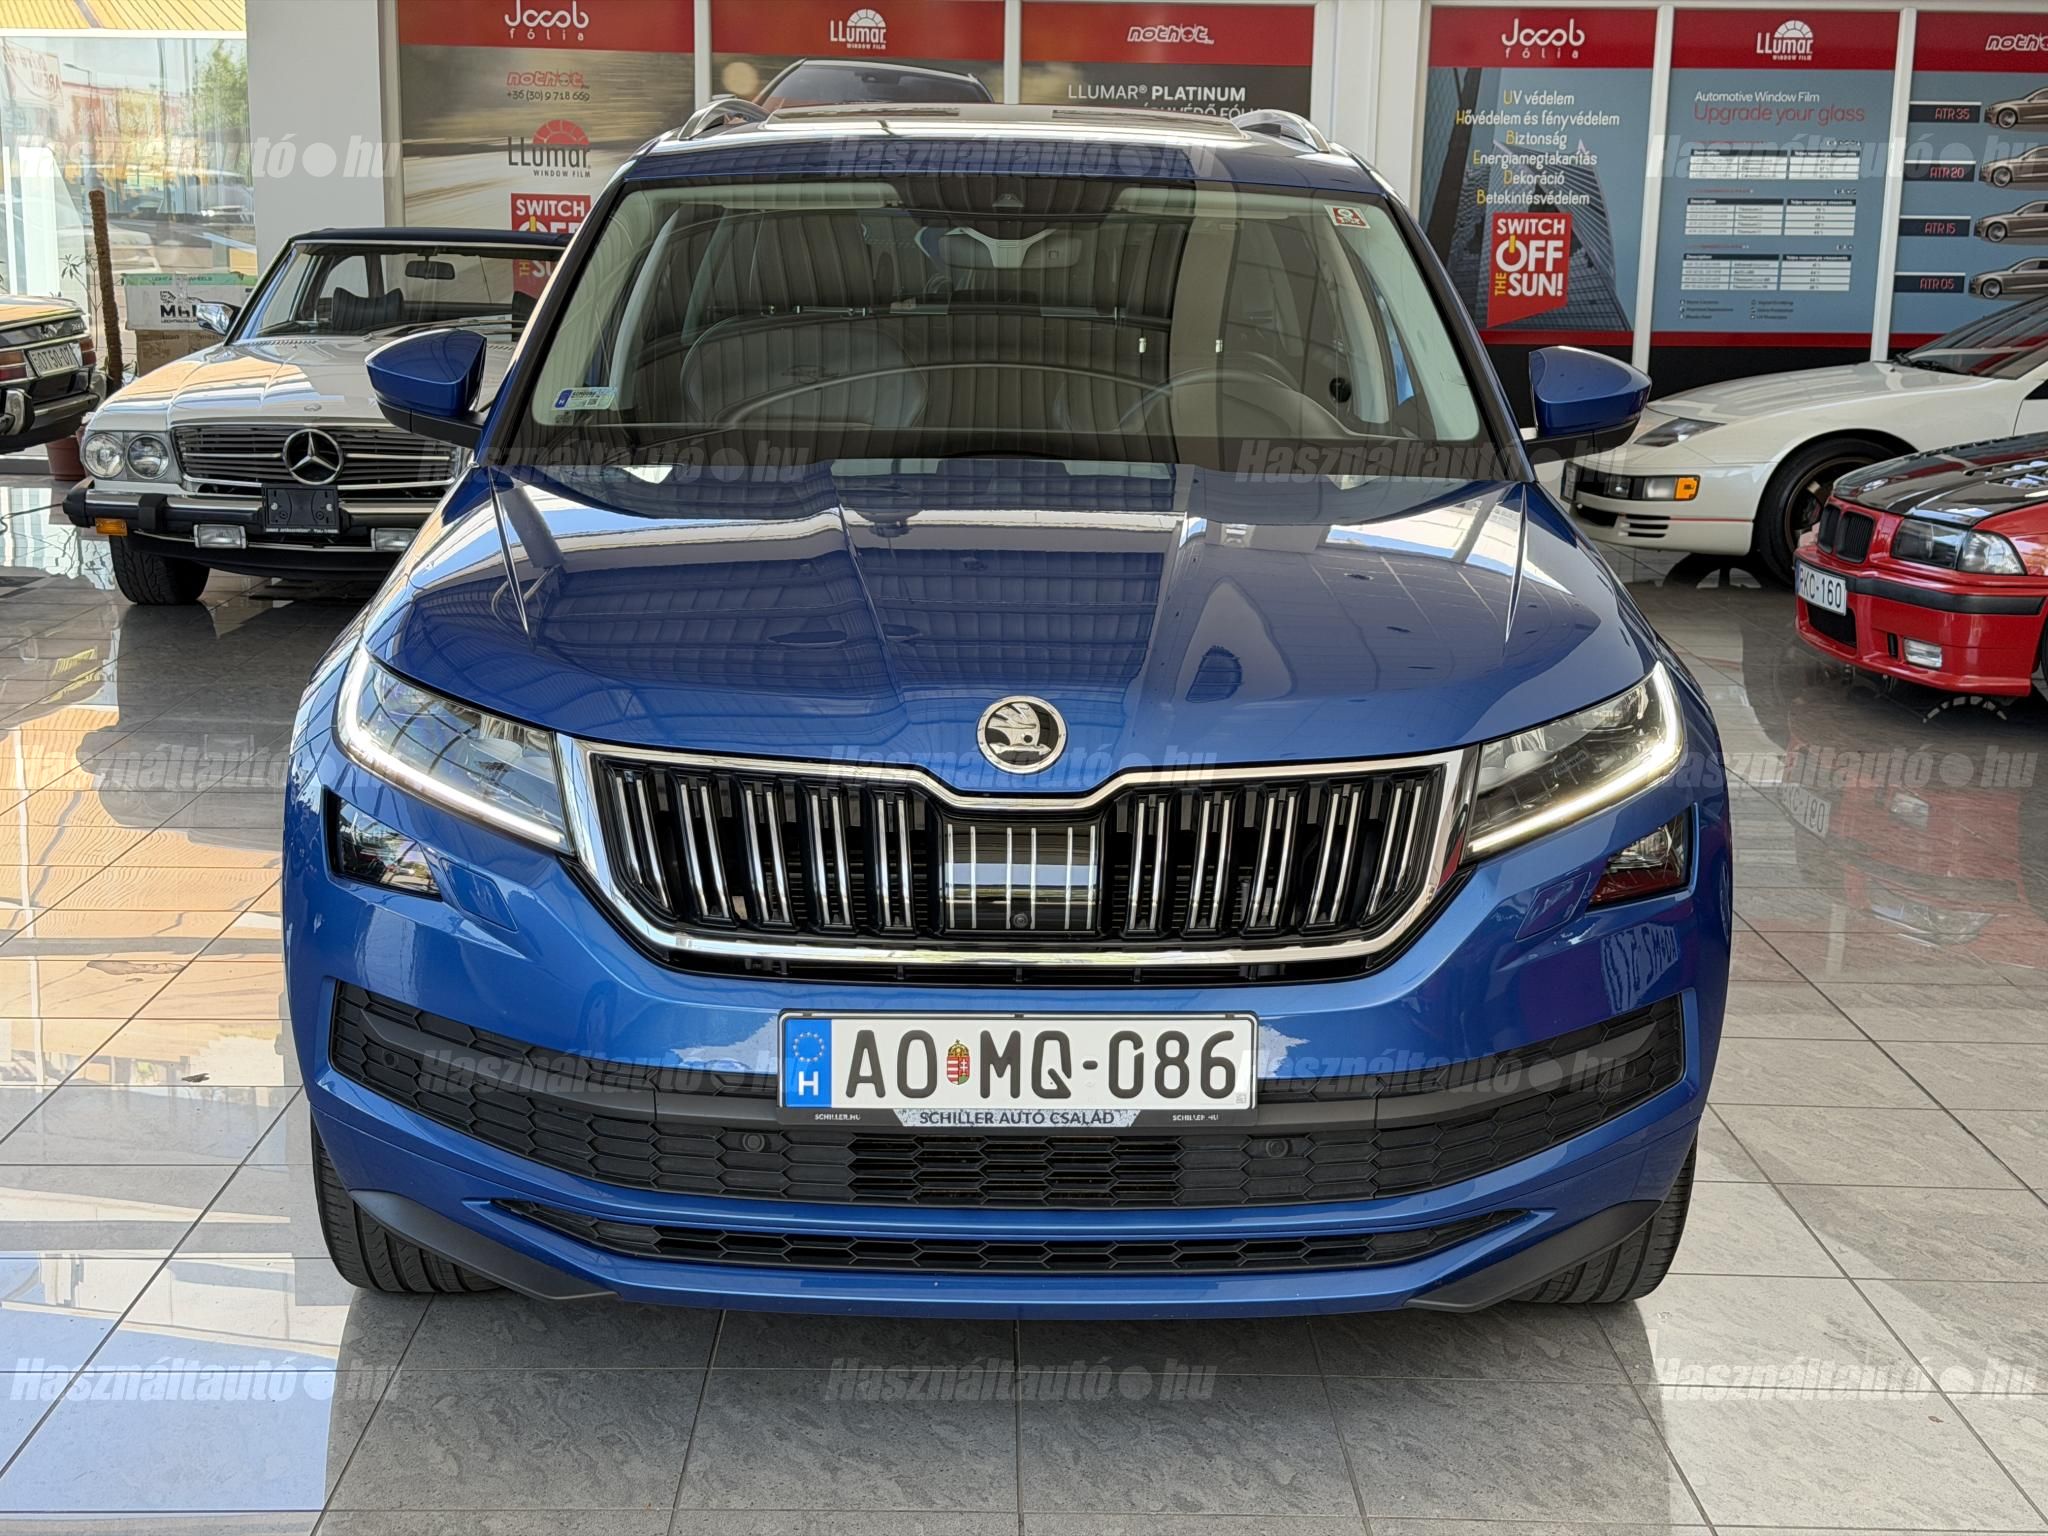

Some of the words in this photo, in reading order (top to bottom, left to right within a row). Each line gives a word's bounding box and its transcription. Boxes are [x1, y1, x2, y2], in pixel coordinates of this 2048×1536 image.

[509, 28, 584, 41] fólia
[830, 20, 887, 43] LLumar
[1756, 32, 1814, 54] LLumar
[1505, 48, 1579, 59] fólia
[526, 90, 543, 102] (30)
[545, 92, 551, 101] 9
[553, 92, 570, 101] 718
[1152, 86, 1246, 101] PLATINUM
[1504, 91, 1522, 105] UV
[1525, 91, 1575, 105] védelem
[1695, 92, 1752, 102] Automotive
[1755, 92, 1796, 102] Window
[1798, 92, 1820, 102] Film
[1456, 109, 1521, 125] Hővédelem
[1524, 110, 1538, 125] és
[1694, 105, 1773, 125] Upgrade
[1776, 108, 1815, 126] your
[1818, 106, 1865, 126] glass
[1506, 130, 1567, 148] Biztonság
[508, 136, 591, 168] LLumar
[1473, 150, 1597, 168] Energiamegtakarítás
[1504, 170, 1565, 184] Dekoráció
[1477, 189, 1590, 204] Betekintésvédelem
[516, 199, 585, 217] SWITCH
[1497, 218, 1566, 235] SWITCH
[1496, 235, 1564, 272] OFF
[1494, 272, 1507, 297] THE
[1507, 272, 1564, 297] SUN!
[846, 1029, 937, 1099] AO
[980, 1029, 1237, 1099] MQ-086
[798, 1070, 820, 1096] H
[919, 1111, 994, 1125] SCHILLER
[999, 1109, 1045, 1125] AUTÓ
[1050, 1109, 1115, 1126] CSALÁD
